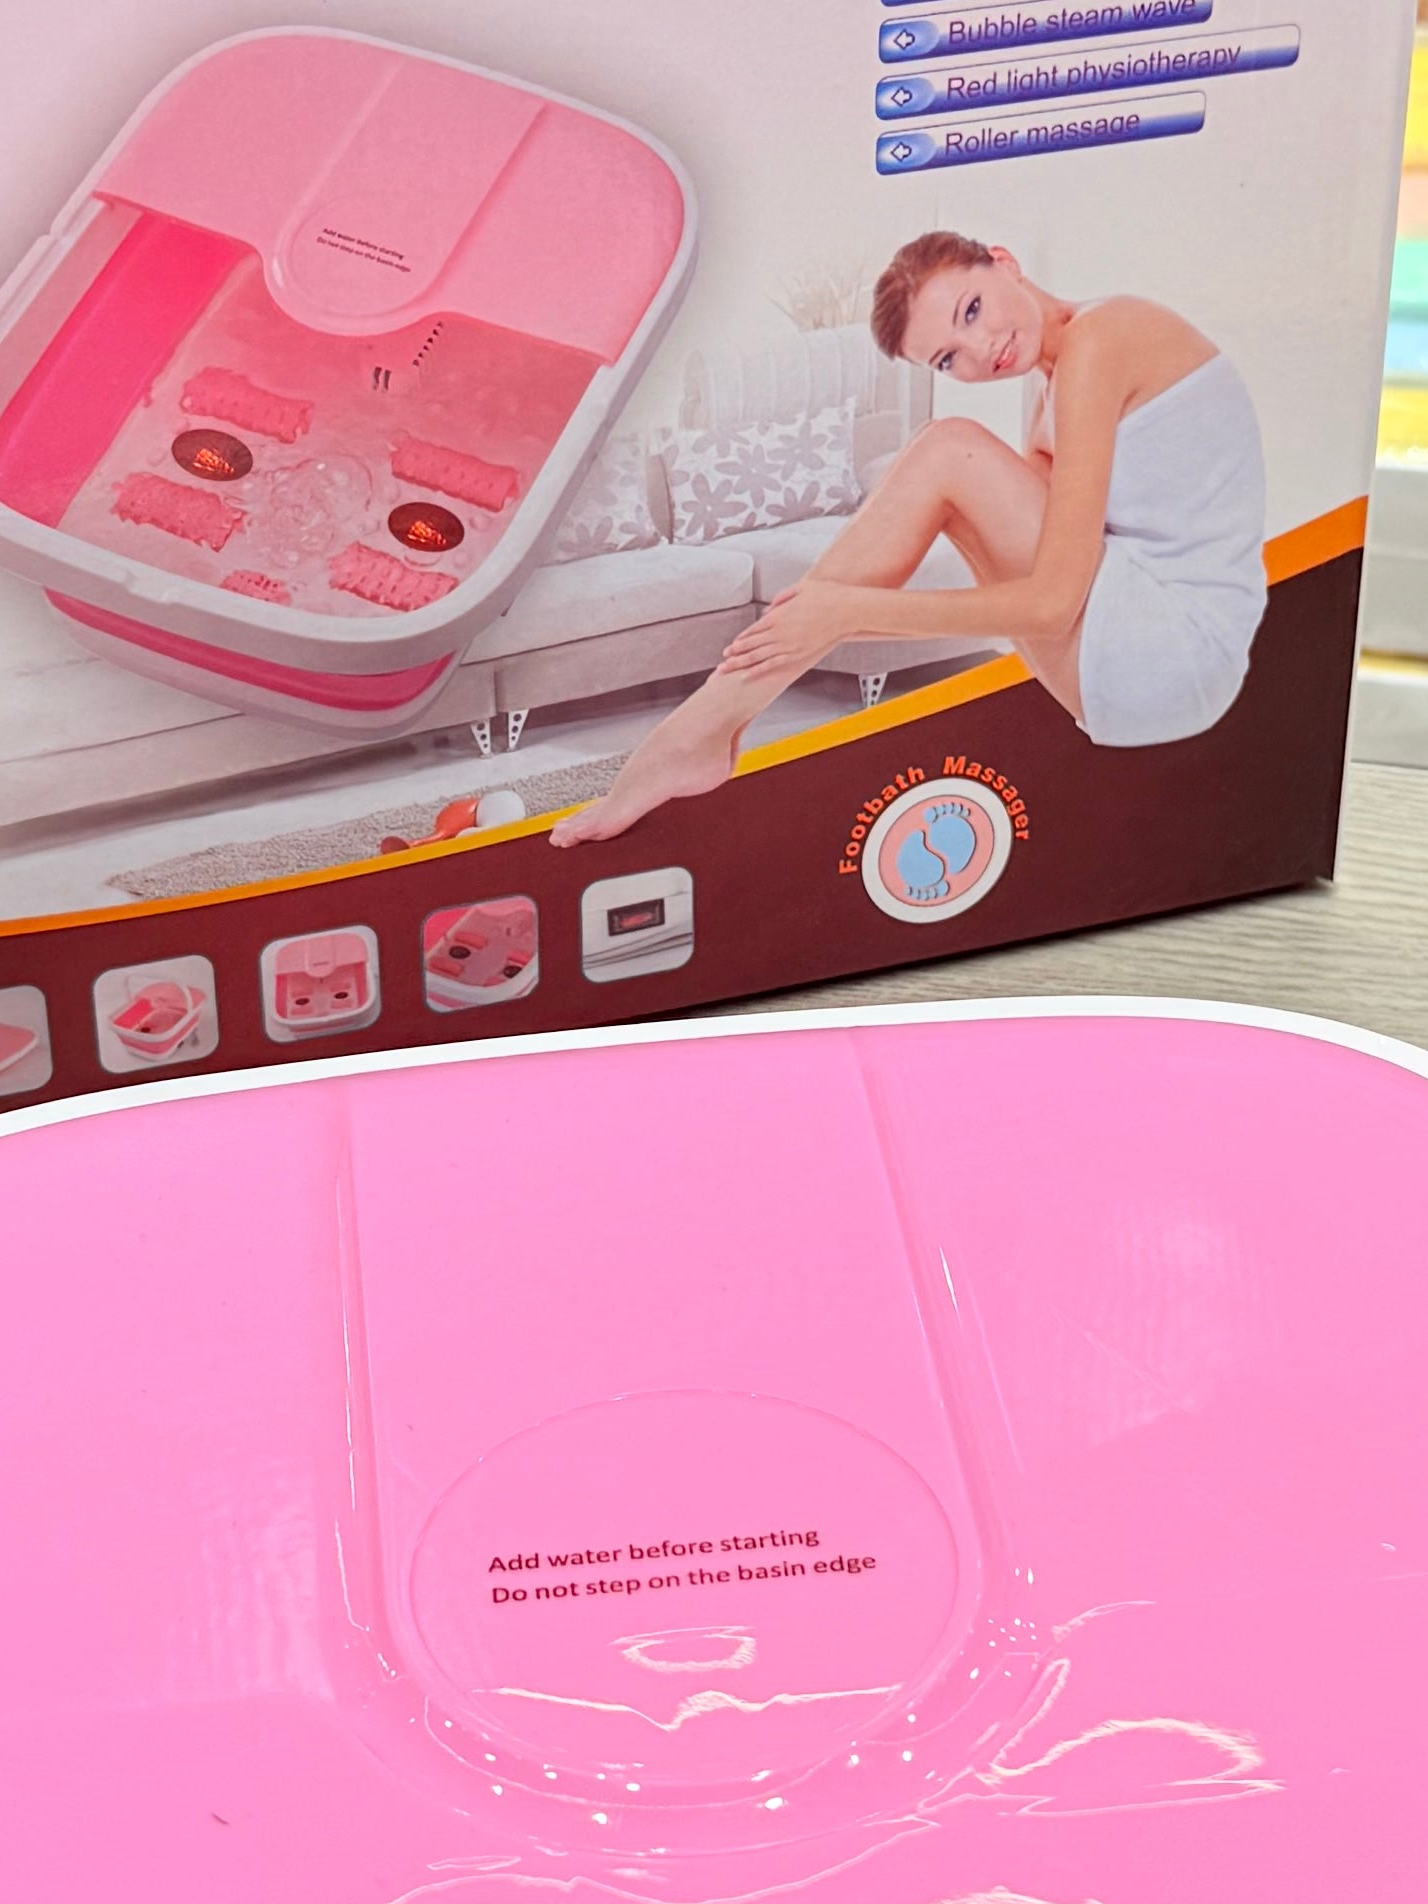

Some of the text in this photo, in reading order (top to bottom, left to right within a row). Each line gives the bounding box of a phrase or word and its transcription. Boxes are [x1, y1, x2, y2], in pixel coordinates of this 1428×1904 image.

[948, 12, 1038, 47] Bubble
[1044, 1, 1124, 34] steam
[946, 43, 1243, 102] Red light physiotherapy
[943, 111, 1141, 157] Roller massage
[837, 755, 1030, 875] Footbath Massager
[488, 1527, 821, 1574] Add water before starting
[491, 1551, 878, 1604] Do not step on the basin edge
